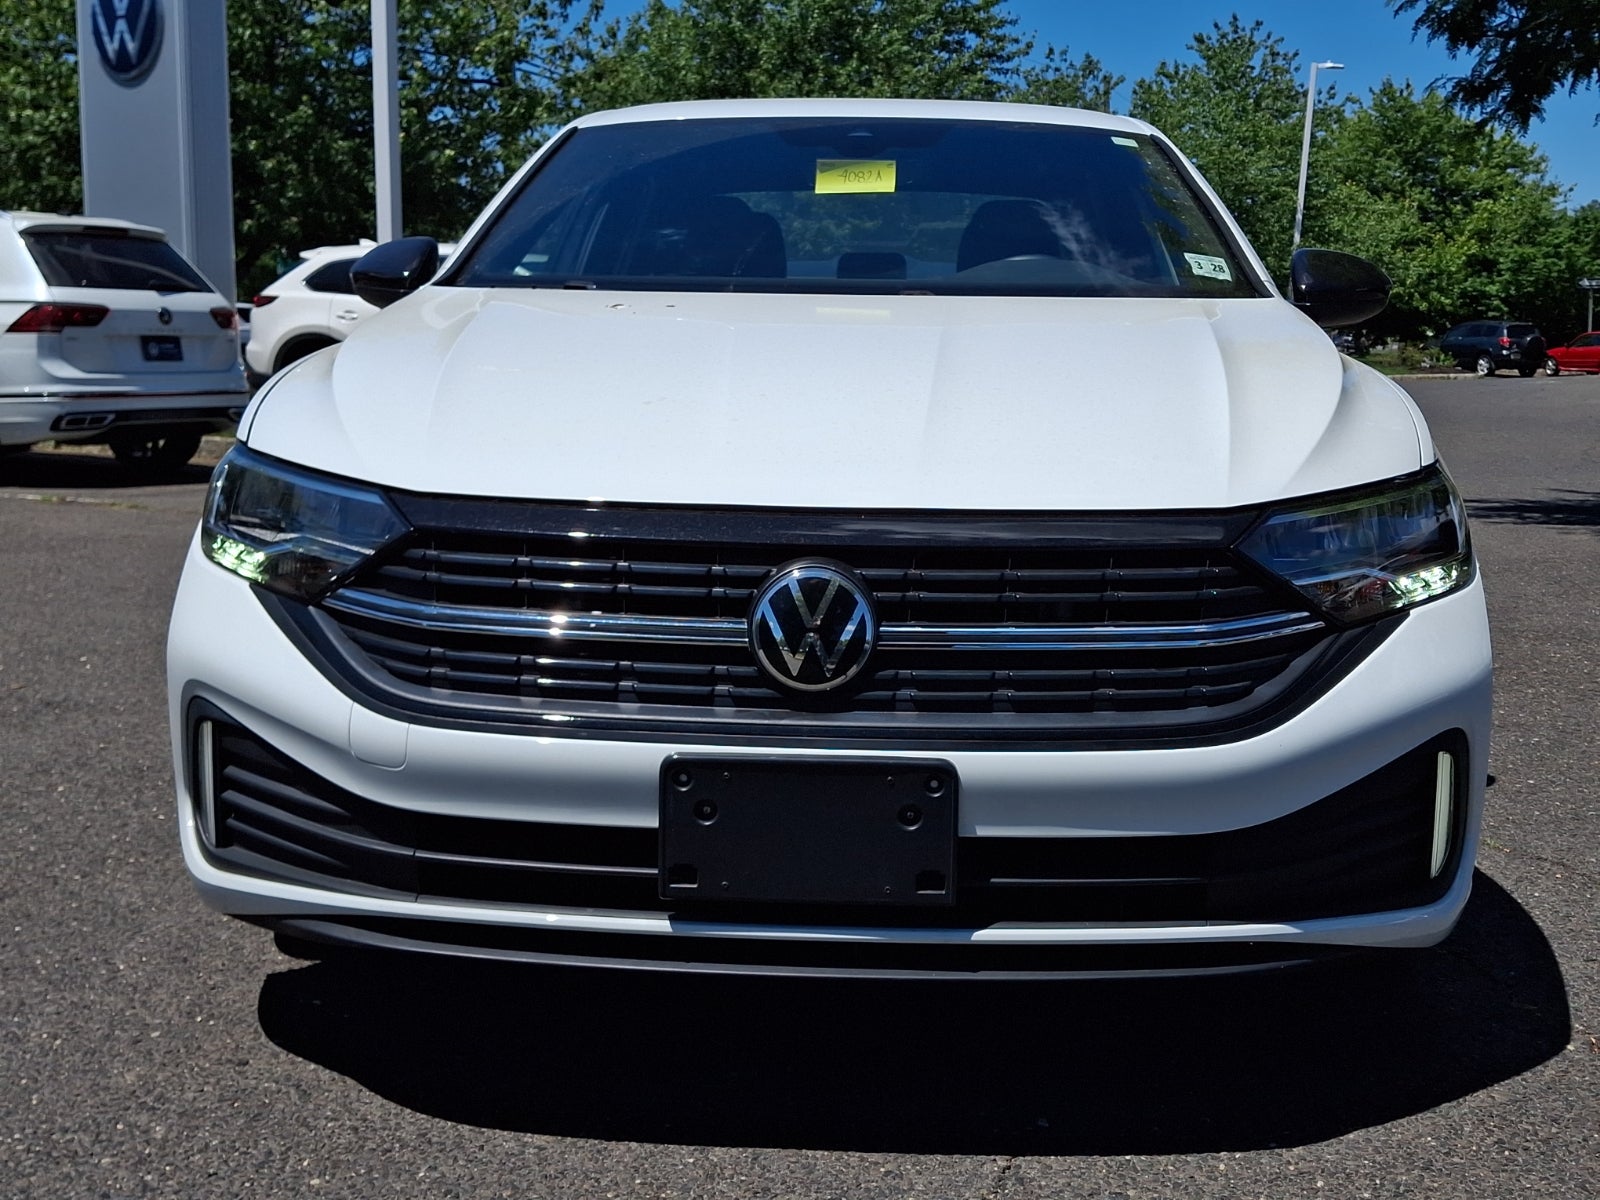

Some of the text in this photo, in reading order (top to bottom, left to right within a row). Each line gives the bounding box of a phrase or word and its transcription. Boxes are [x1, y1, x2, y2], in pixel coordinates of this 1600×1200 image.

[1194, 260, 1226, 273] 3 28
[760, 574, 867, 678] VW
